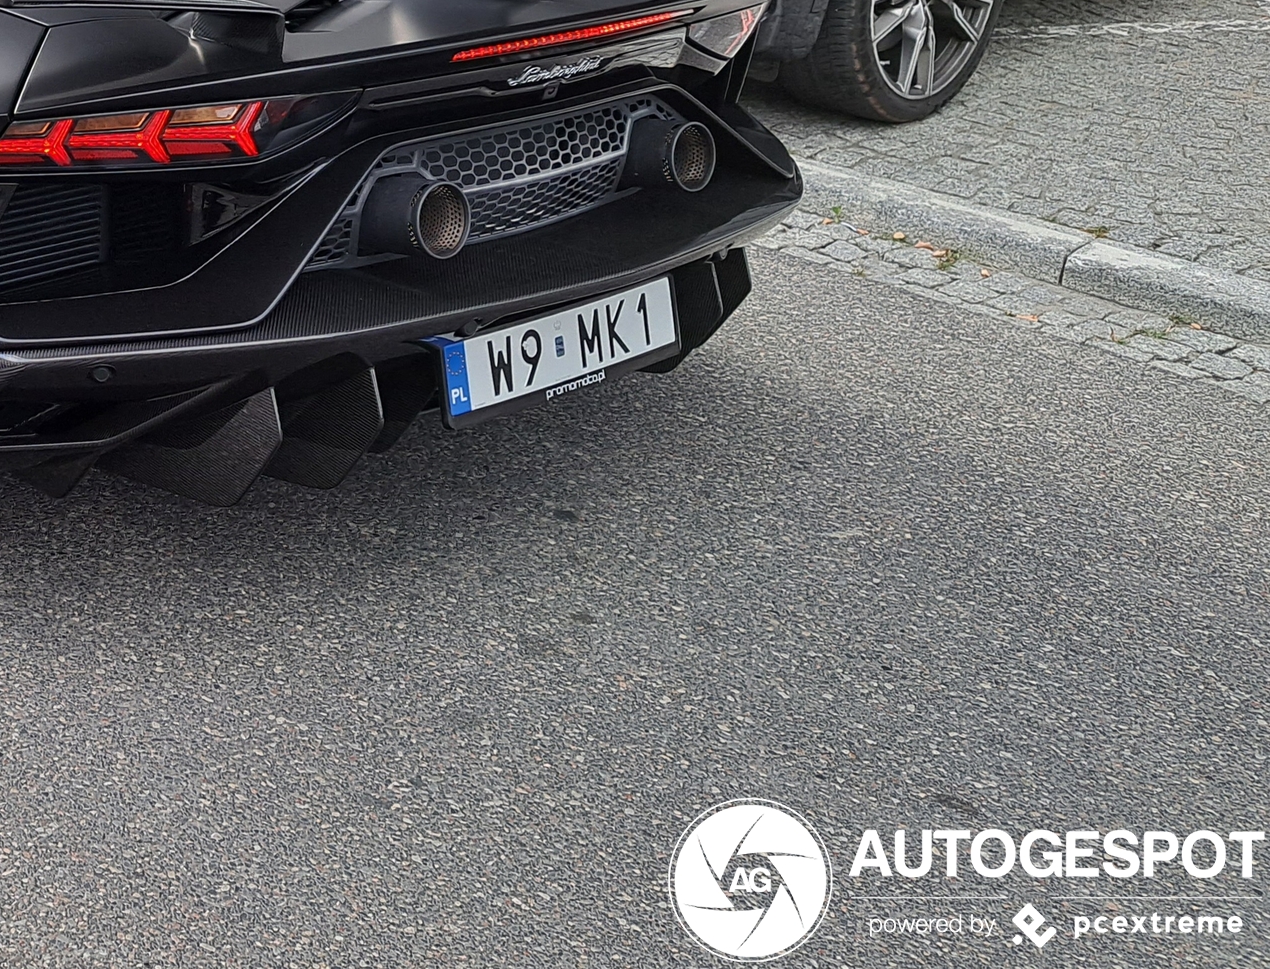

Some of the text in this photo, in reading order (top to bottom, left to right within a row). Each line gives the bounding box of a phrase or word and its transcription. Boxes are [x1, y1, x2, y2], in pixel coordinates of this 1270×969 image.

[487, 328, 542, 397] W9
[451, 386, 468, 405] PL
[545, 369, 607, 401] promomoto.pl
